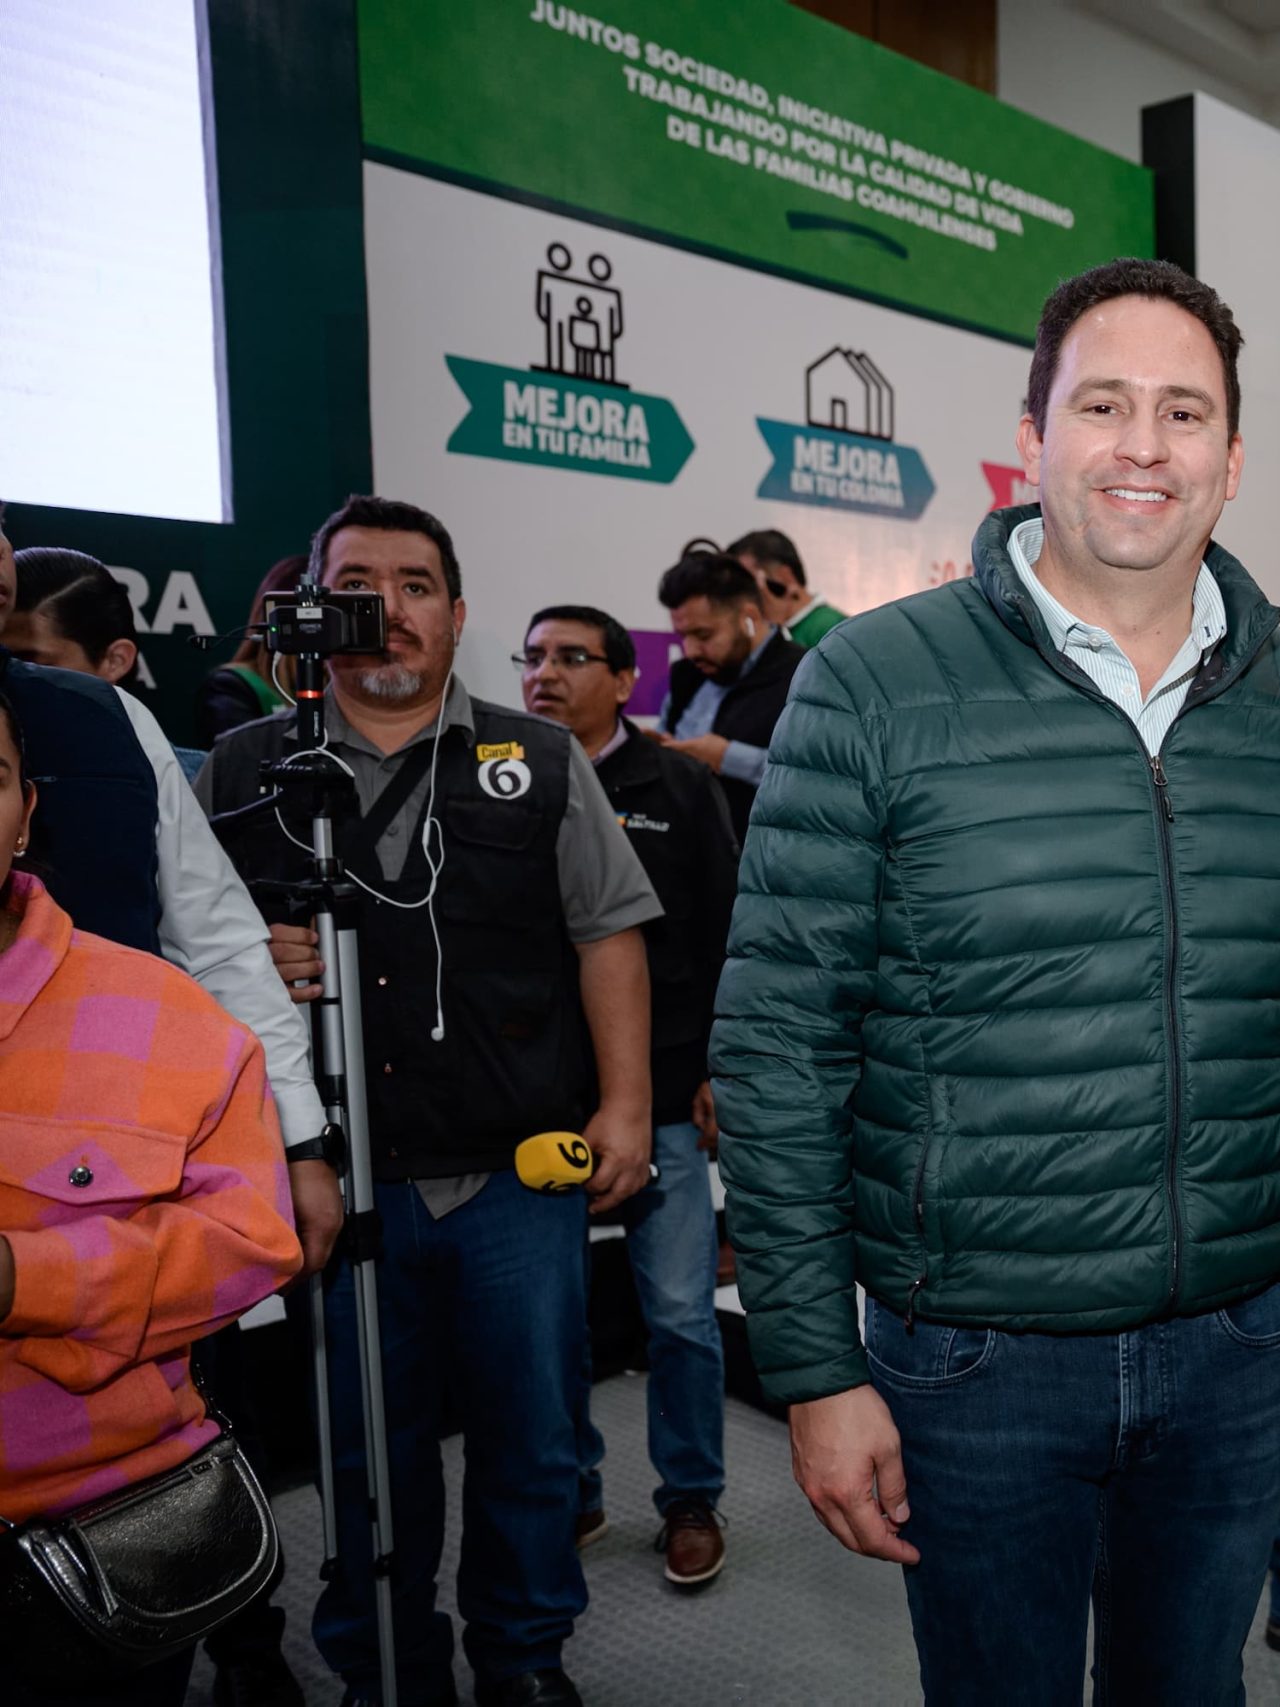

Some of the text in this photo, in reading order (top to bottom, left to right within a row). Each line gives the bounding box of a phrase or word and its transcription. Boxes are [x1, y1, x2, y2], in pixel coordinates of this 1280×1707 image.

[530, 0, 1075, 229] JUNTOS SOCIEDAD, INICIATIVA PRIVADA Y GOBIERNO
[622, 65, 1024, 236] TRABAJANDO POR LA CALIDAD DE VIDA
[667, 115, 997, 251] DE LAS FAMILIAS COAHUILENSES
[503, 380, 650, 443] MEJORA
[502, 422, 652, 469] EN TU FAMILIA
[793, 435, 902, 486] MEJORA
[790, 469, 814, 494] EN
[815, 475, 838, 498] TU
[481, 744, 513, 759] Canal
[485, 758, 524, 798] 6
[556, 1140, 589, 1169] 6
